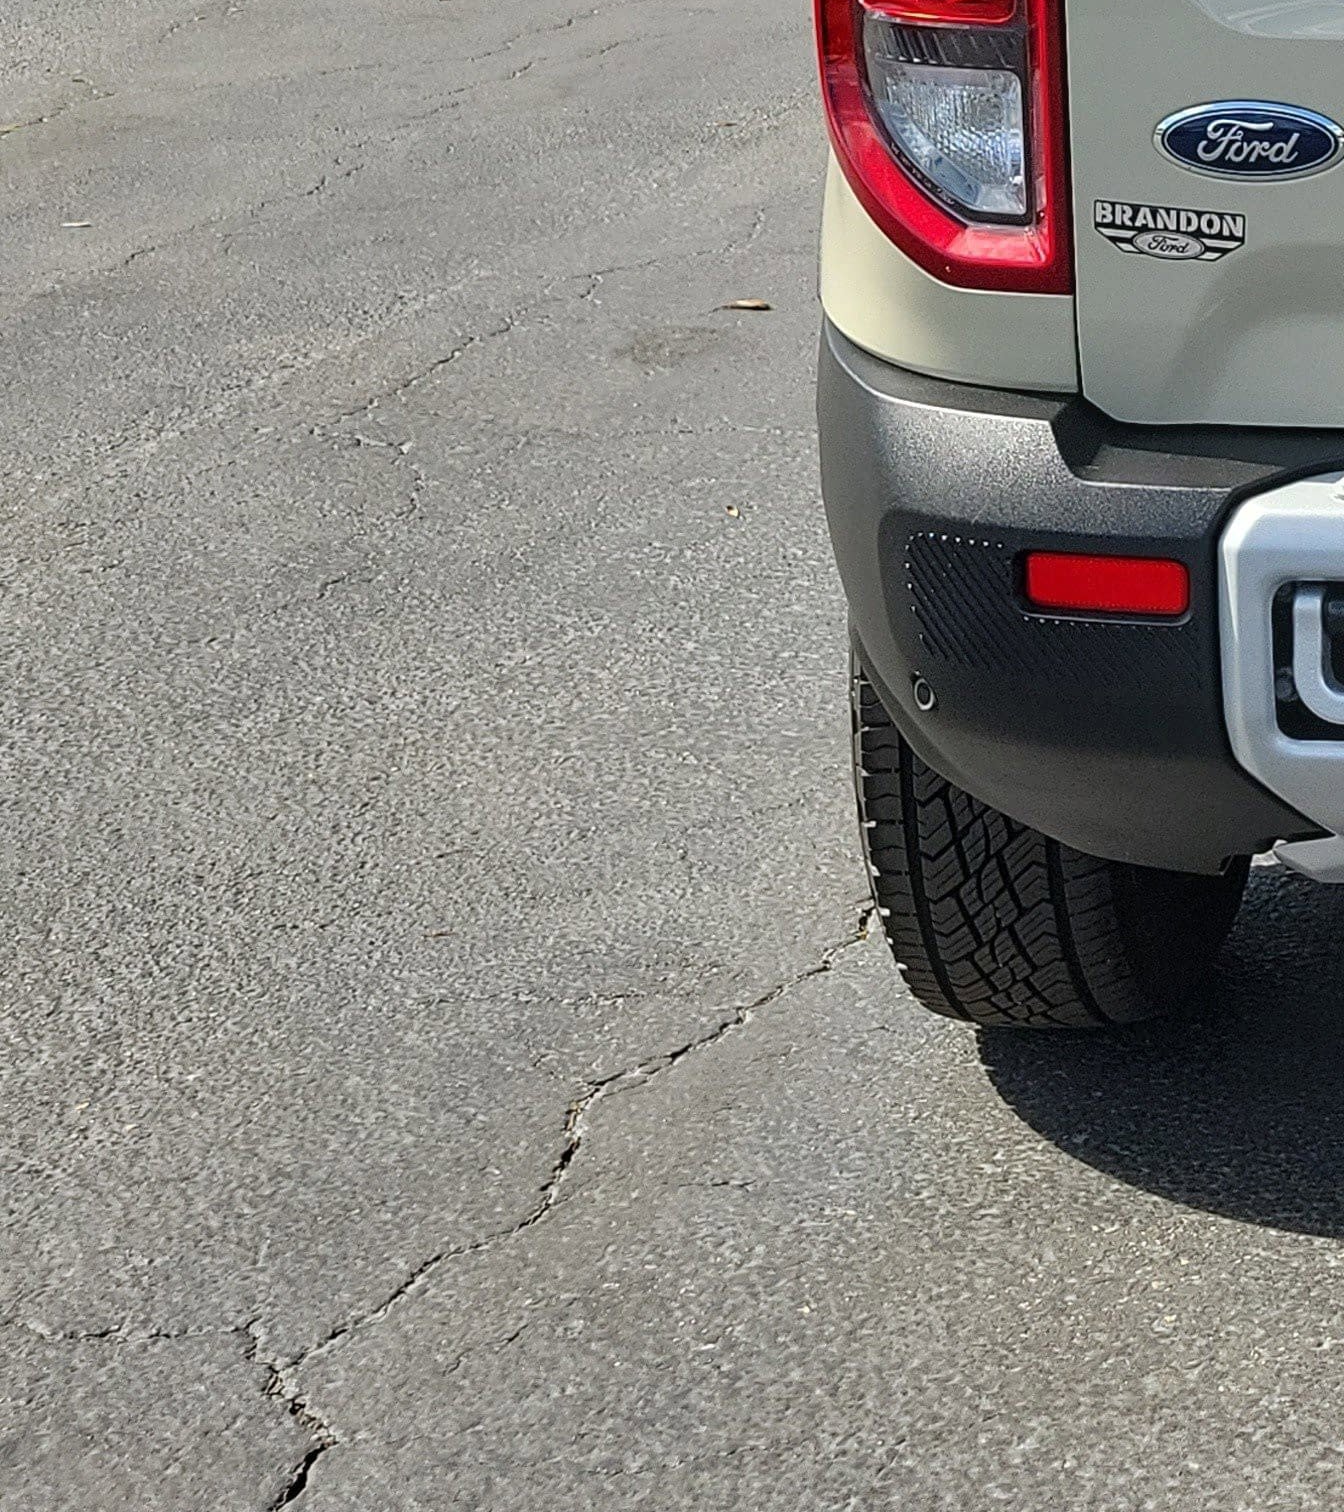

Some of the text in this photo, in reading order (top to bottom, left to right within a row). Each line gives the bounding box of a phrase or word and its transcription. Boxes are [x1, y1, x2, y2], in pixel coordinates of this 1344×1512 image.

[1196, 119, 1300, 164] Ford
[1095, 201, 1244, 238] BRANDON
[1147, 235, 1190, 255] Ford
